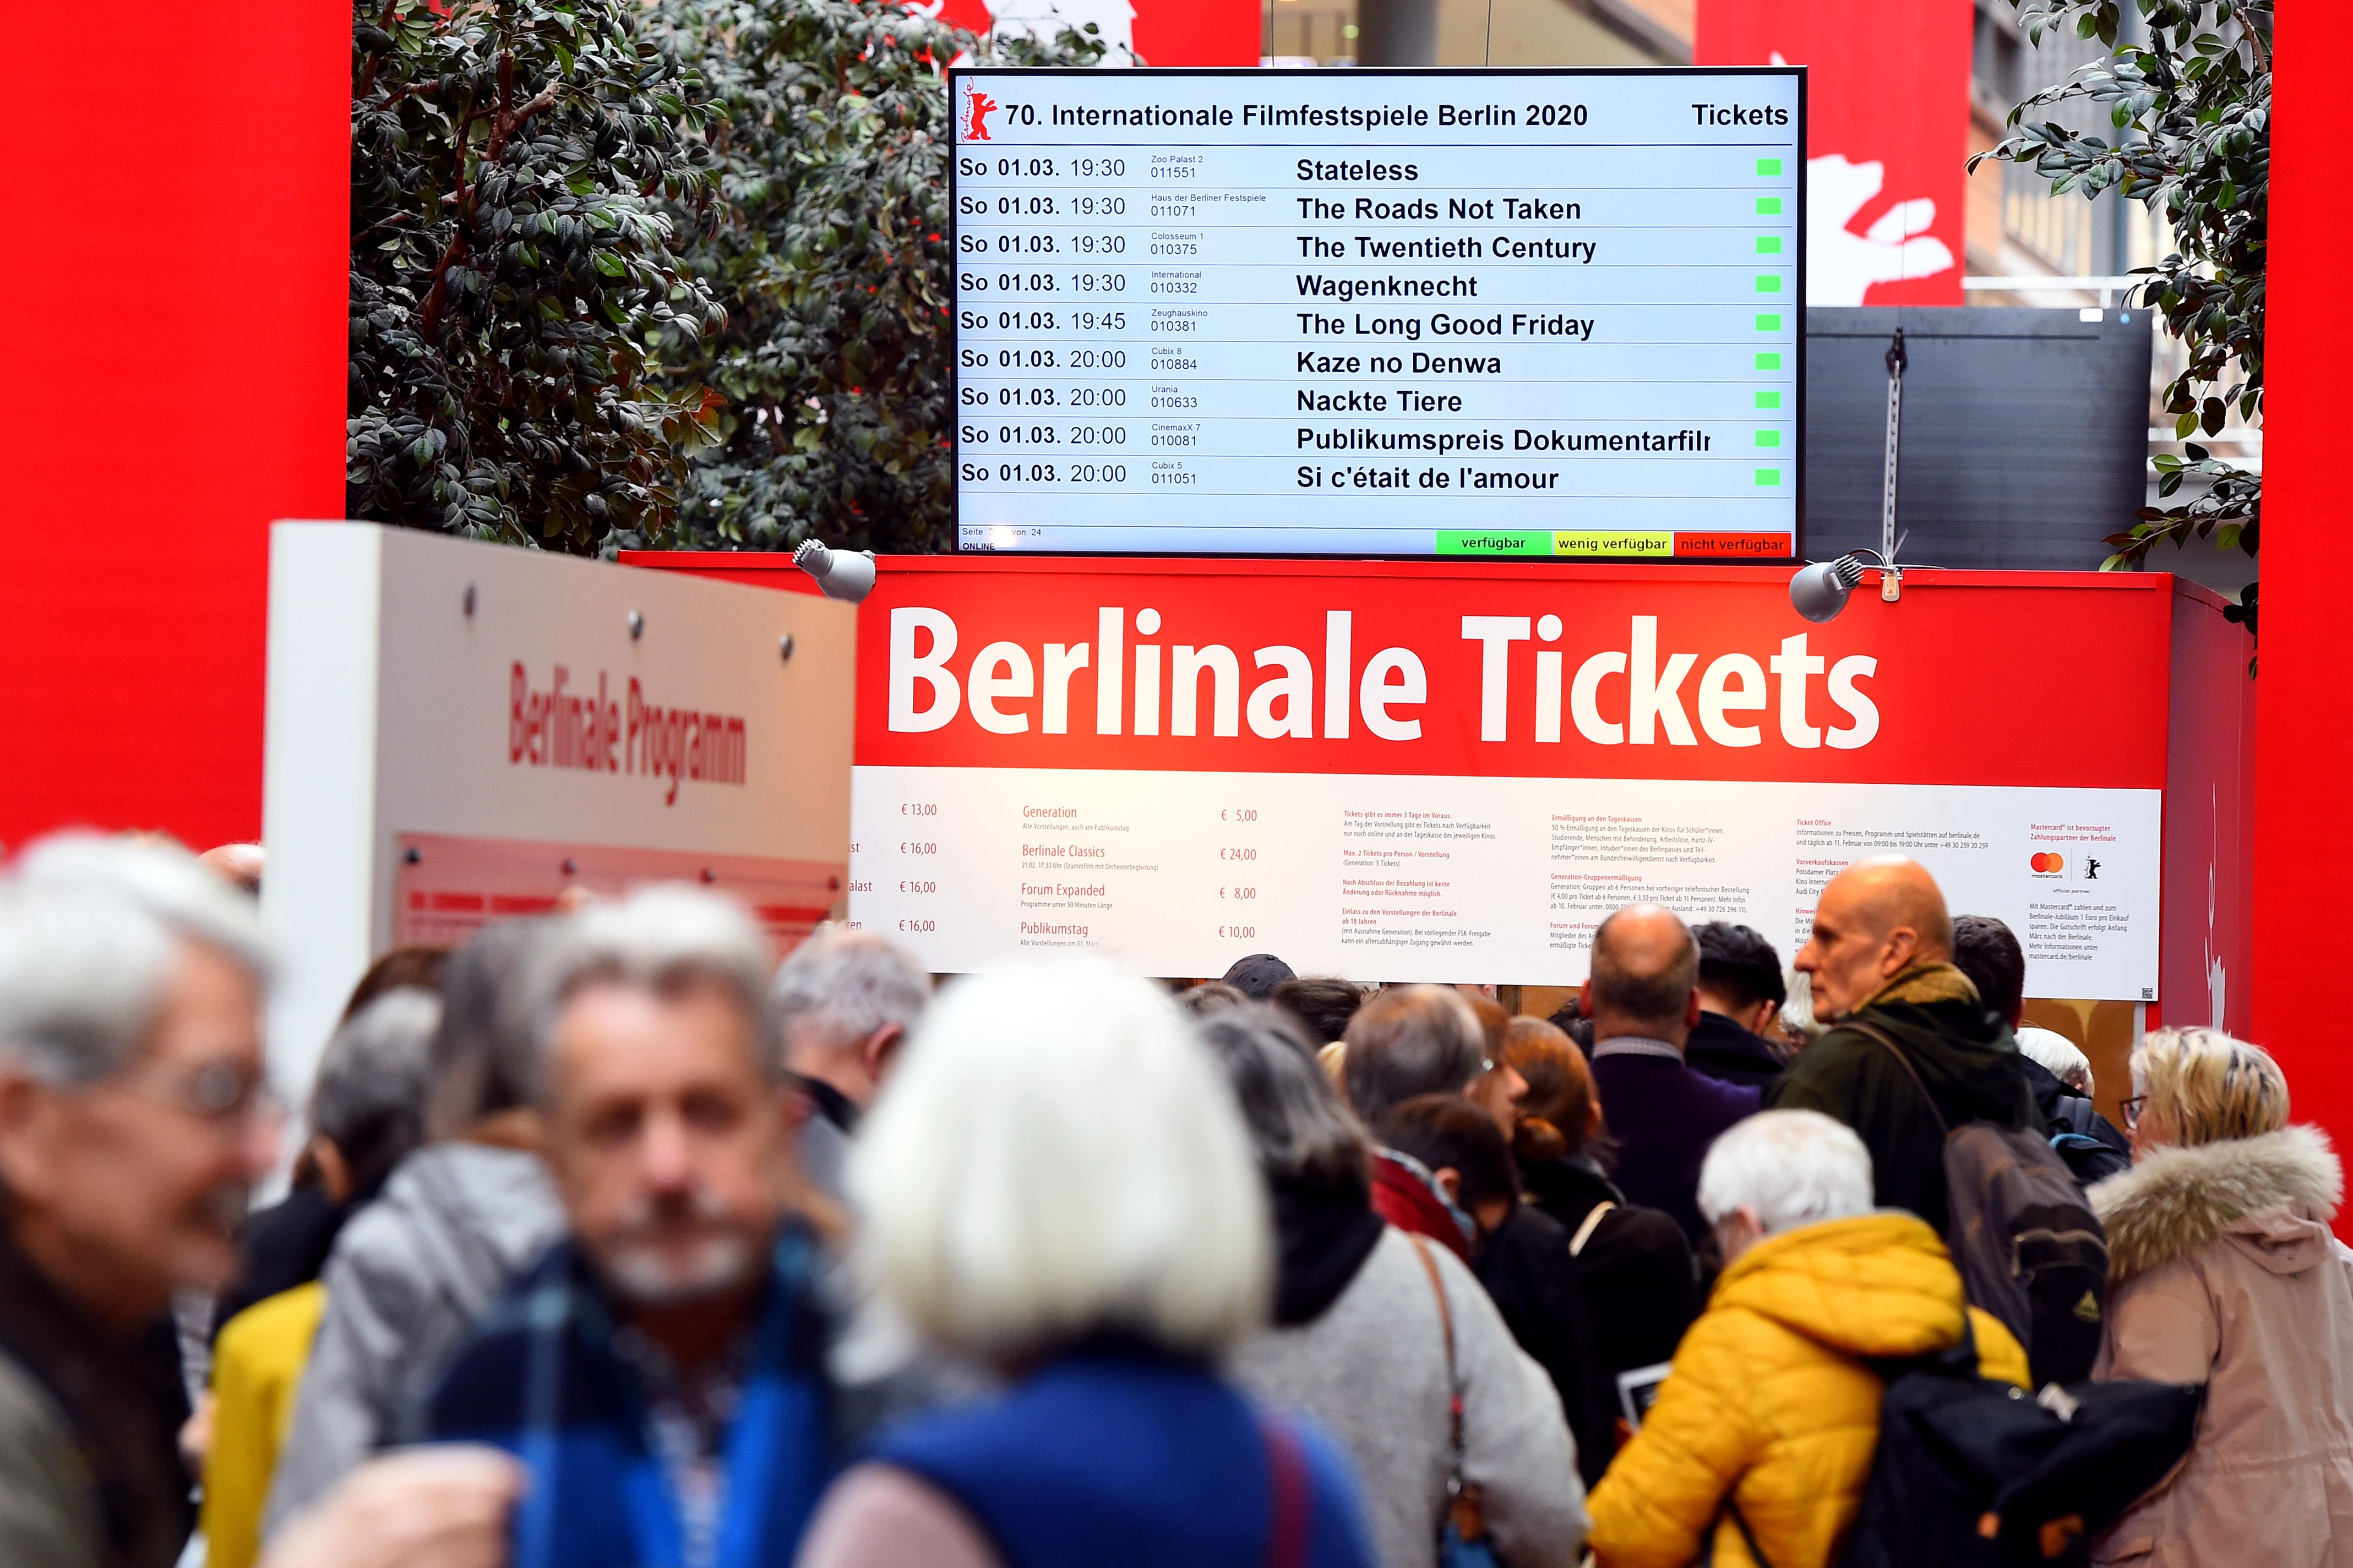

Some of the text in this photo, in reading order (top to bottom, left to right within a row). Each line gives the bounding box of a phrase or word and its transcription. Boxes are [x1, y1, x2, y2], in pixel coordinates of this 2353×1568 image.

[1005, 104, 1588, 132] 70. Internationale Filmfestspiele Berlin 2020
[1691, 104, 1789, 125] Tickets
[960, 157, 1125, 176] So 01.03. 19:30
[1151, 167, 1195, 178] 011551
[1297, 159, 1418, 181] Stateless
[960, 196, 1125, 215] So 01.03. 19:30
[1224, 194, 1266, 203] Festspiele
[1151, 205, 1195, 216] 011071
[1297, 198, 1581, 220] The Roads Not Taken
[1151, 232, 1197, 240] Colosseum
[960, 234, 1125, 253] So 01.03. 19:30
[1151, 244, 1197, 255] 010375
[1297, 236, 1597, 264] The Twentieth Century
[1152, 270, 1201, 278] International
[960, 272, 1125, 292] So 01.03. 19:30
[1151, 282, 1197, 293] 010332
[1296, 275, 1478, 302] Wagenknecht
[961, 311, 1126, 330] So 01.03. 19:45
[1151, 309, 1208, 319] Zeughauskino
[1151, 320, 1195, 331] 010381
[1297, 313, 1595, 341] The Long Good Friday
[1151, 347, 1174, 355] Cubix
[961, 349, 1126, 368] So 01.03. 20:00
[1151, 358, 1197, 370] 010884
[1298, 351, 1501, 374] Kaze no Denwa
[961, 387, 1126, 406] So 01.03. 20:00
[1151, 397, 1197, 408] 010633
[1298, 390, 1462, 412] Nackte Tiere
[1152, 423, 1193, 431] CinemaxX
[961, 425, 1126, 444] So 01.03. 20:00
[1151, 435, 1196, 446] 010081
[1298, 428, 1504, 455] Publikumspreis
[1152, 461, 1183, 469] Cubix 5
[961, 463, 1126, 482] So 01.03. 20:00
[1152, 473, 1195, 484] 011051
[1297, 466, 1559, 489] Si c'était de l'amour
[962, 527, 983, 536] Seite
[1462, 537, 1526, 551] verfügbar
[1559, 538, 1668, 552] wenig verfügbar
[1681, 538, 1784, 553] nicht verfügbar
[888, 607, 1880, 750] Berlinale Tickets
[509, 660, 748, 806] Berlinale Programm
[901, 804, 937, 817] € 13,00
[1023, 805, 1077, 818] Generation
[1221, 809, 1257, 823] € 5,00
[1552, 814, 1586, 823] Ermäßigung
[1608, 815, 1642, 824] Tageskassen
[2030, 833, 2078, 842] Zahlungspartner
[901, 842, 936, 856] € 16,00
[1022, 844, 1105, 857] Berlinale Classics
[1220, 848, 1256, 862] € 24,00
[1418, 851, 1450, 860] Vorstellung
[1796, 859, 1849, 867] Vorverkaufskassen
[1550, 873, 1642, 883] Generation-Gruppenermäßigung
[849, 879, 873, 892] alast
[900, 881, 936, 894] € 16,00
[1022, 883, 1105, 899] Forum Expanded
[1219, 887, 1256, 901] € 8,00
[1021, 900, 1051, 909] Programme
[1097, 902, 1113, 910] Länge
[898, 920, 935, 933] € 16,00
[1021, 922, 1088, 938] Publikumstag
[1219, 926, 1255, 939] € 10,00
